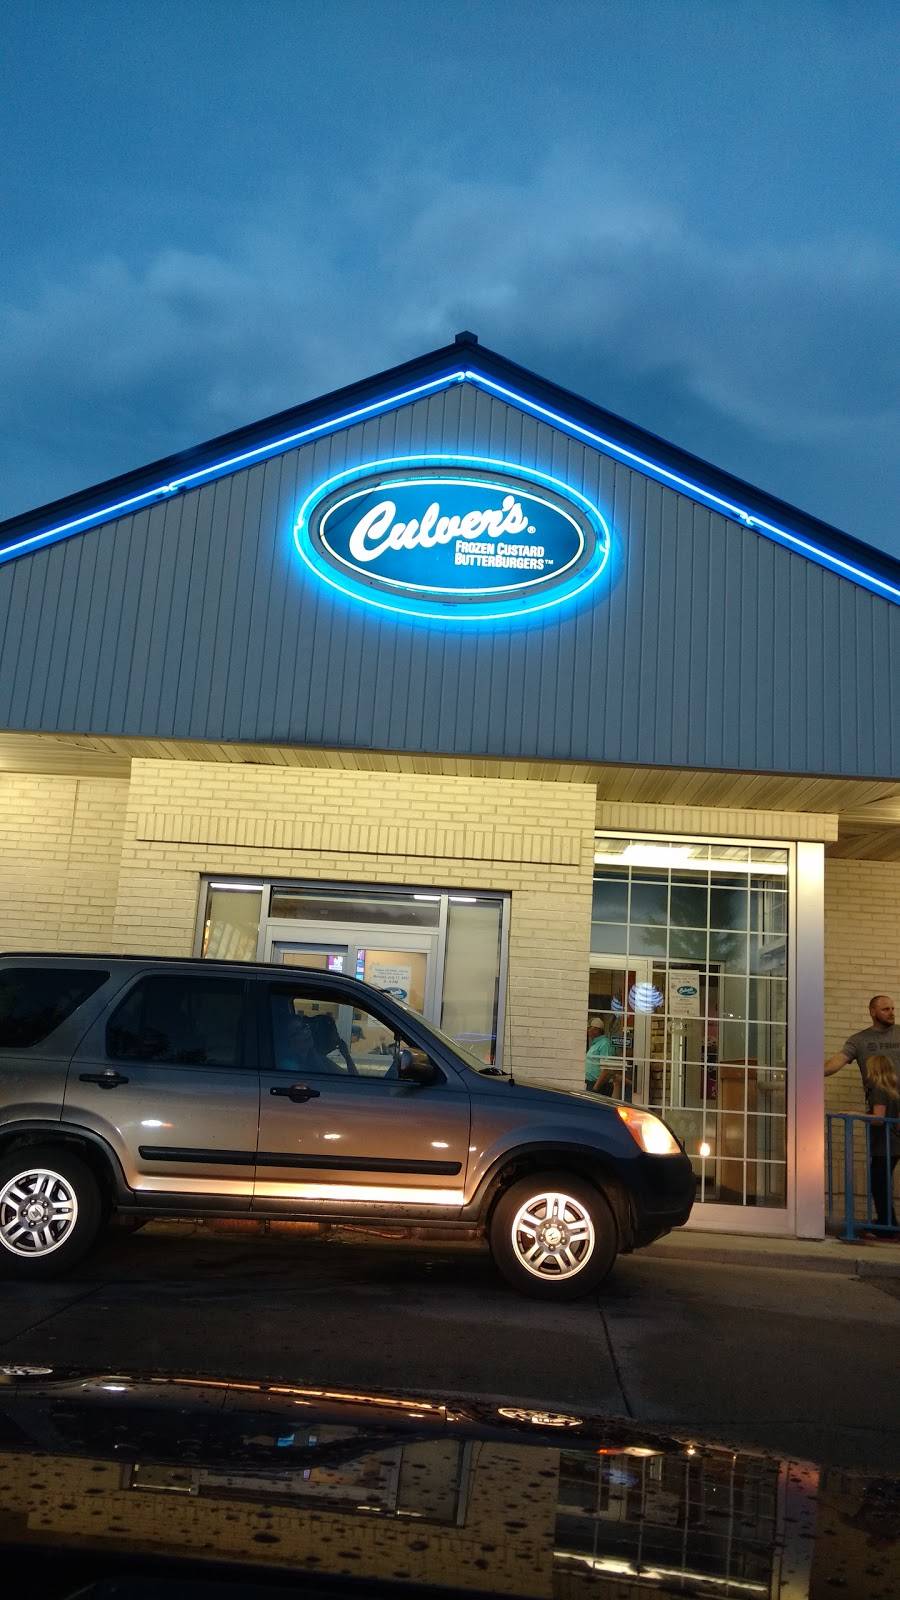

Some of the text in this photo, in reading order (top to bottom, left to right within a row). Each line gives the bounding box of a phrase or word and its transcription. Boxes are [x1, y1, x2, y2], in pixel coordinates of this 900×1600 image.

[349, 495, 528, 562] Culver's
[455, 540, 544, 558] FROZEN CUSTARD
